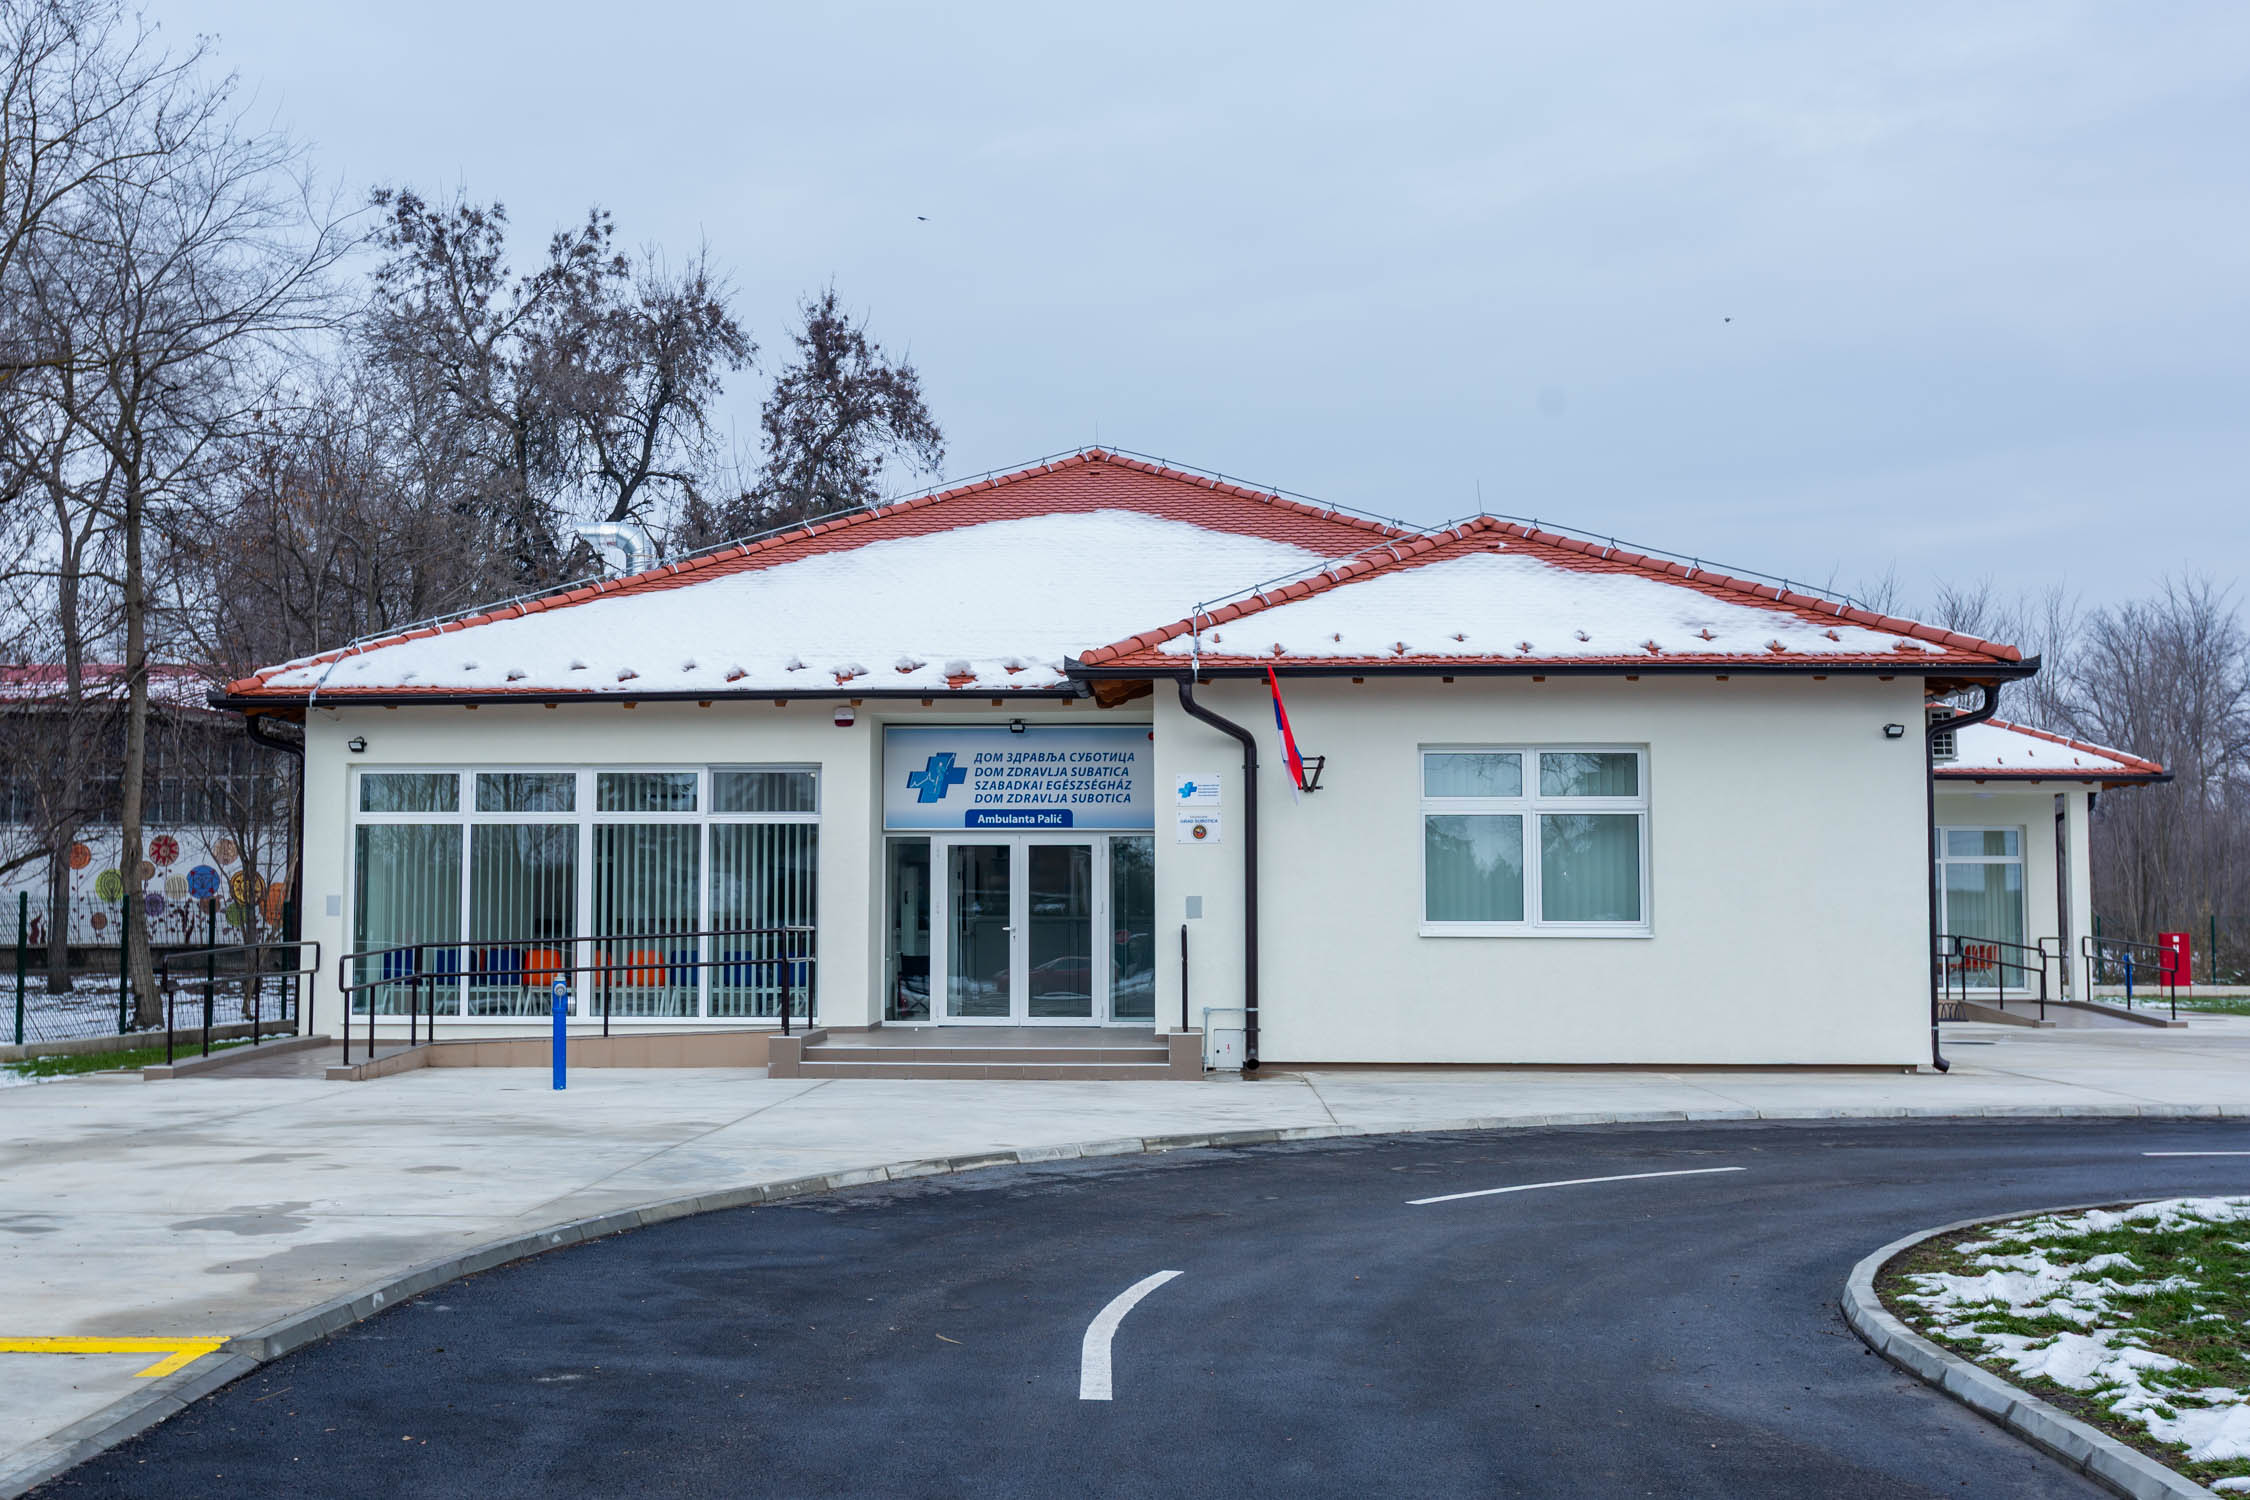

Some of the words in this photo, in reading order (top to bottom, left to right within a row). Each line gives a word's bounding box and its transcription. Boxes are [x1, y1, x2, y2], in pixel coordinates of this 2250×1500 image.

[974, 752, 1003, 764] ДОМ
[1006, 752, 1066, 764] ЗДРАВЉА
[1069, 752, 1135, 764] СУБОТИЦА
[974, 767, 1004, 777] DOM
[1006, 767, 1068, 777] ZDRAVLJA
[1071, 767, 1129, 777] SUBATICA
[974, 780, 1043, 790] SZABADKAI
[1046, 778, 1133, 790] EGÉSZSÉGHÁZ
[974, 793, 1004, 803] DOM
[1006, 793, 1068, 803] ZDRAVLJA
[1071, 793, 1132, 803] SUBOTICA
[977, 814, 1035, 824] Ambulanta
[1037, 814, 1062, 824] Palić
